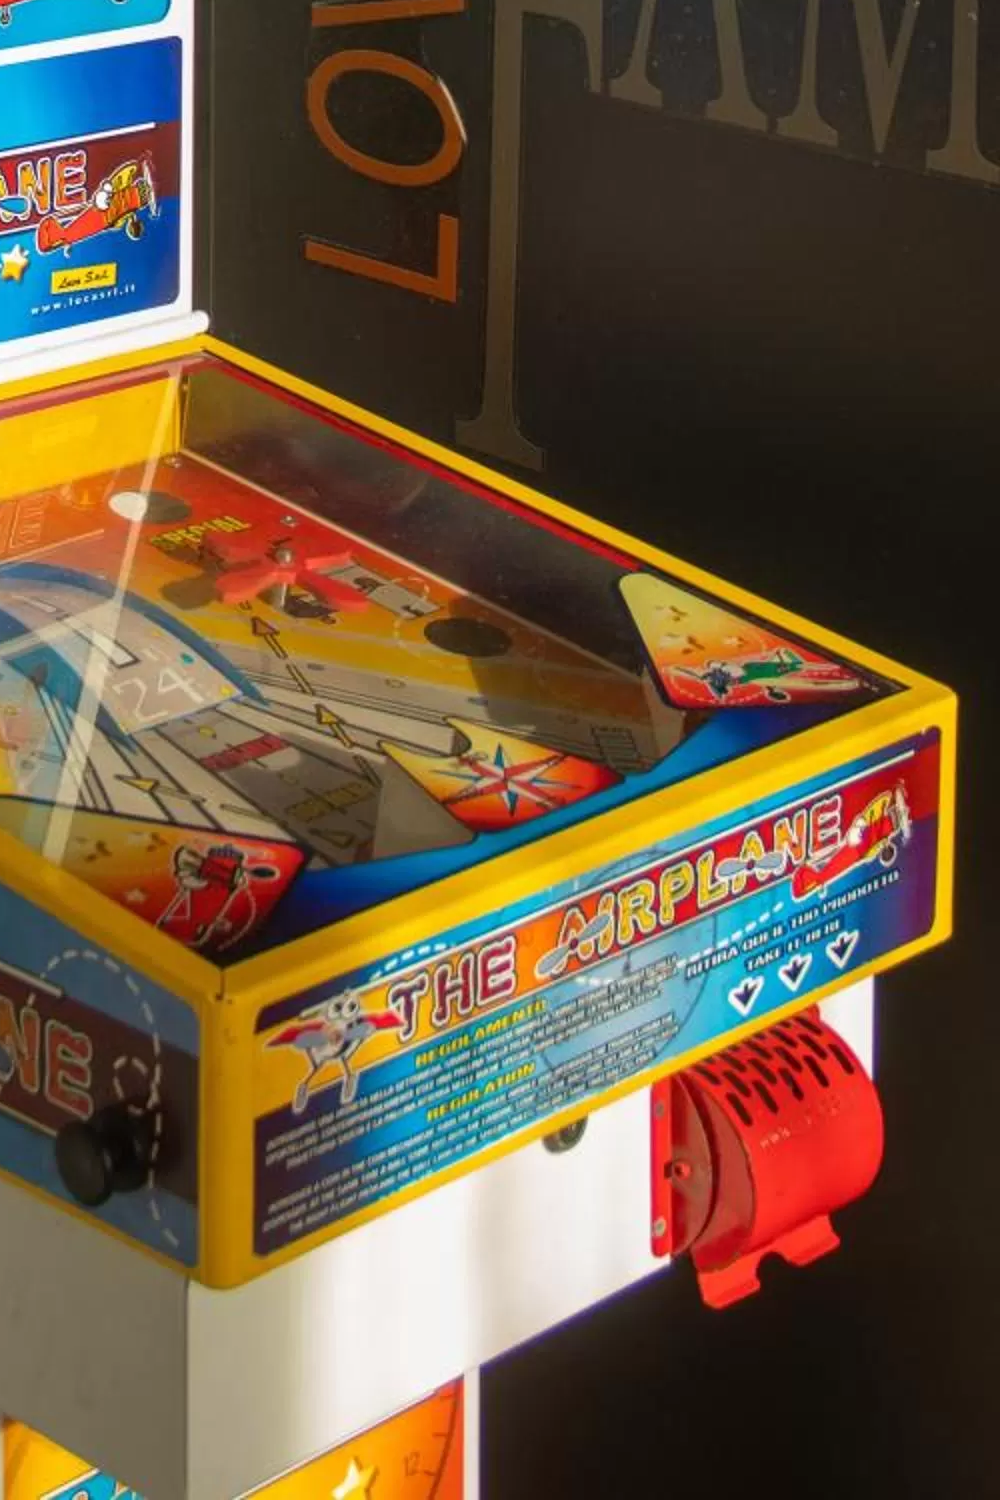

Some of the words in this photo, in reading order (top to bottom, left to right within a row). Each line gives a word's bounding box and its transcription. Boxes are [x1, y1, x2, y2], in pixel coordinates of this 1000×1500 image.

[111, 667, 205, 724] 24
[387, 934, 519, 1042] THE
[536, 792, 845, 979] AIRPLANE
